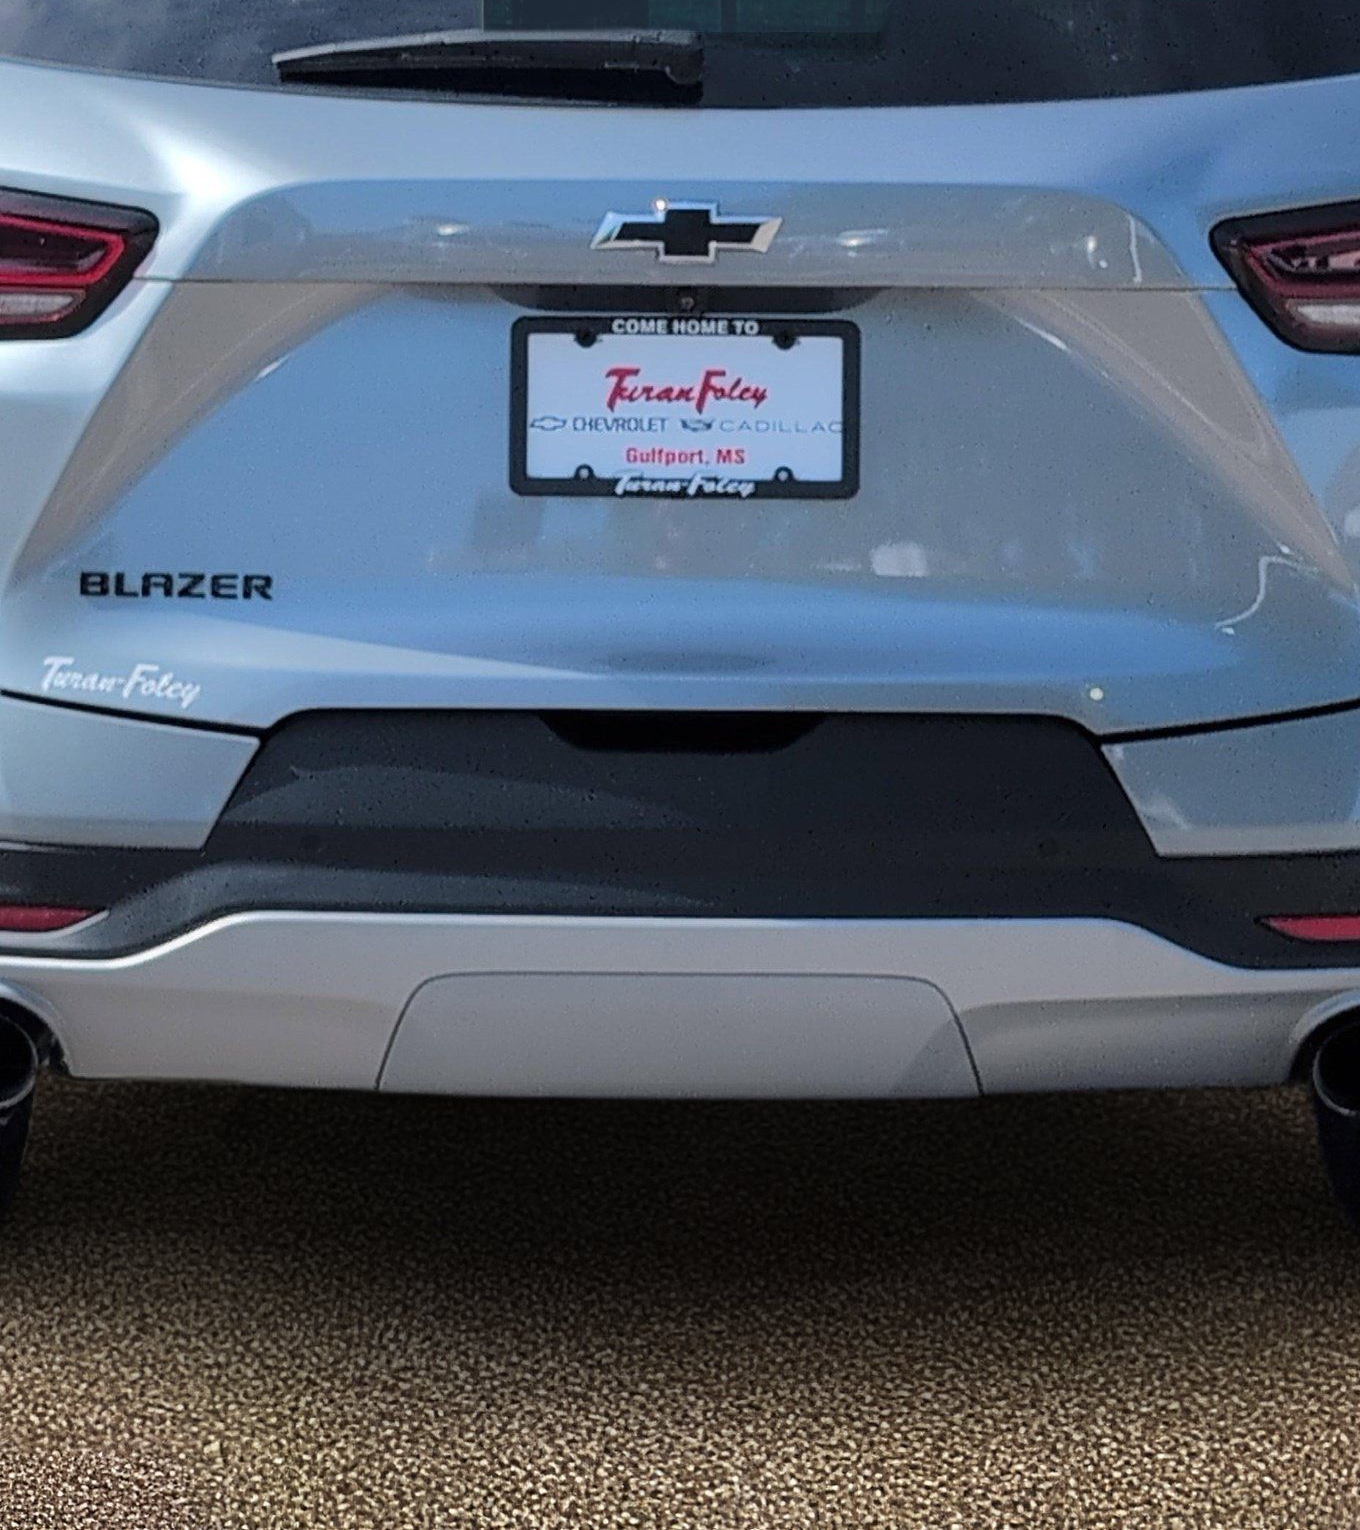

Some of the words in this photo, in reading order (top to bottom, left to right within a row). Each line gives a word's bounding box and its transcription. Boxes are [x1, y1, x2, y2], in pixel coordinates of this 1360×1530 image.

[612, 318, 667, 334] COME
[672, 319, 728, 335] HOME
[732, 320, 760, 336] TO
[605, 367, 695, 413] Turan
[695, 368, 768, 415] Foley
[572, 416, 668, 433] CHEVROLET
[719, 420, 844, 434] CADILLAC
[626, 447, 711, 465] Gulfport,
[716, 449, 745, 465] MS
[80, 571, 273, 601] BLAZER
